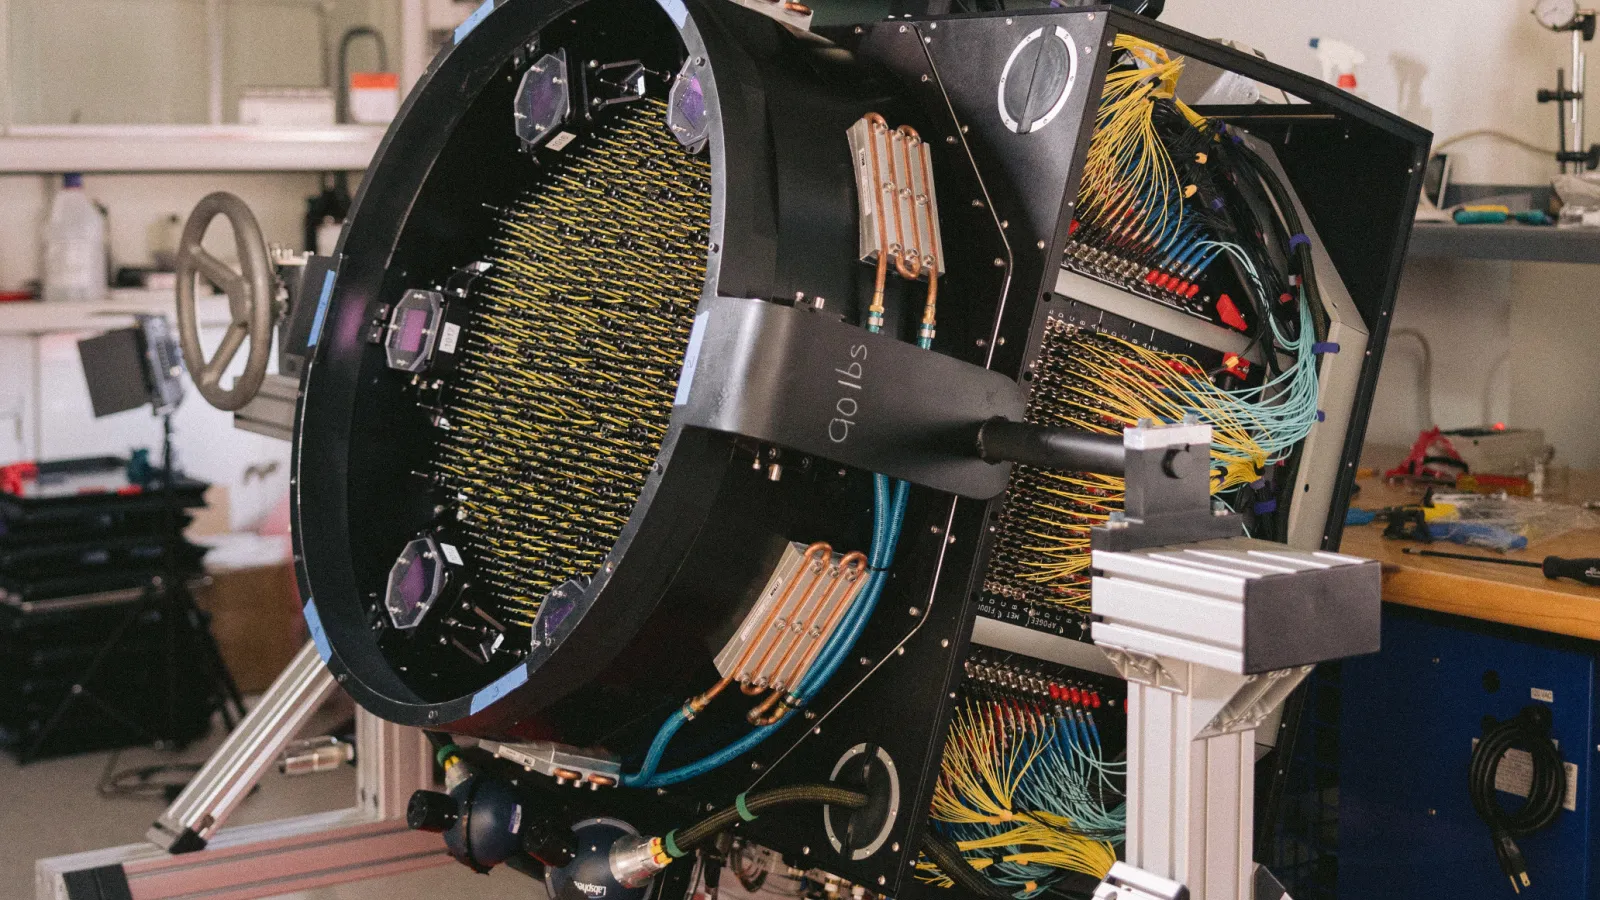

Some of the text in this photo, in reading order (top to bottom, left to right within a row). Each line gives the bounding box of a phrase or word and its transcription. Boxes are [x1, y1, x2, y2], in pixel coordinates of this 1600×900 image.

[828, 343, 868, 444] 90 lbs
[1006, 612, 1020, 620] MET
[1031, 616, 1057, 629] APOGEE
